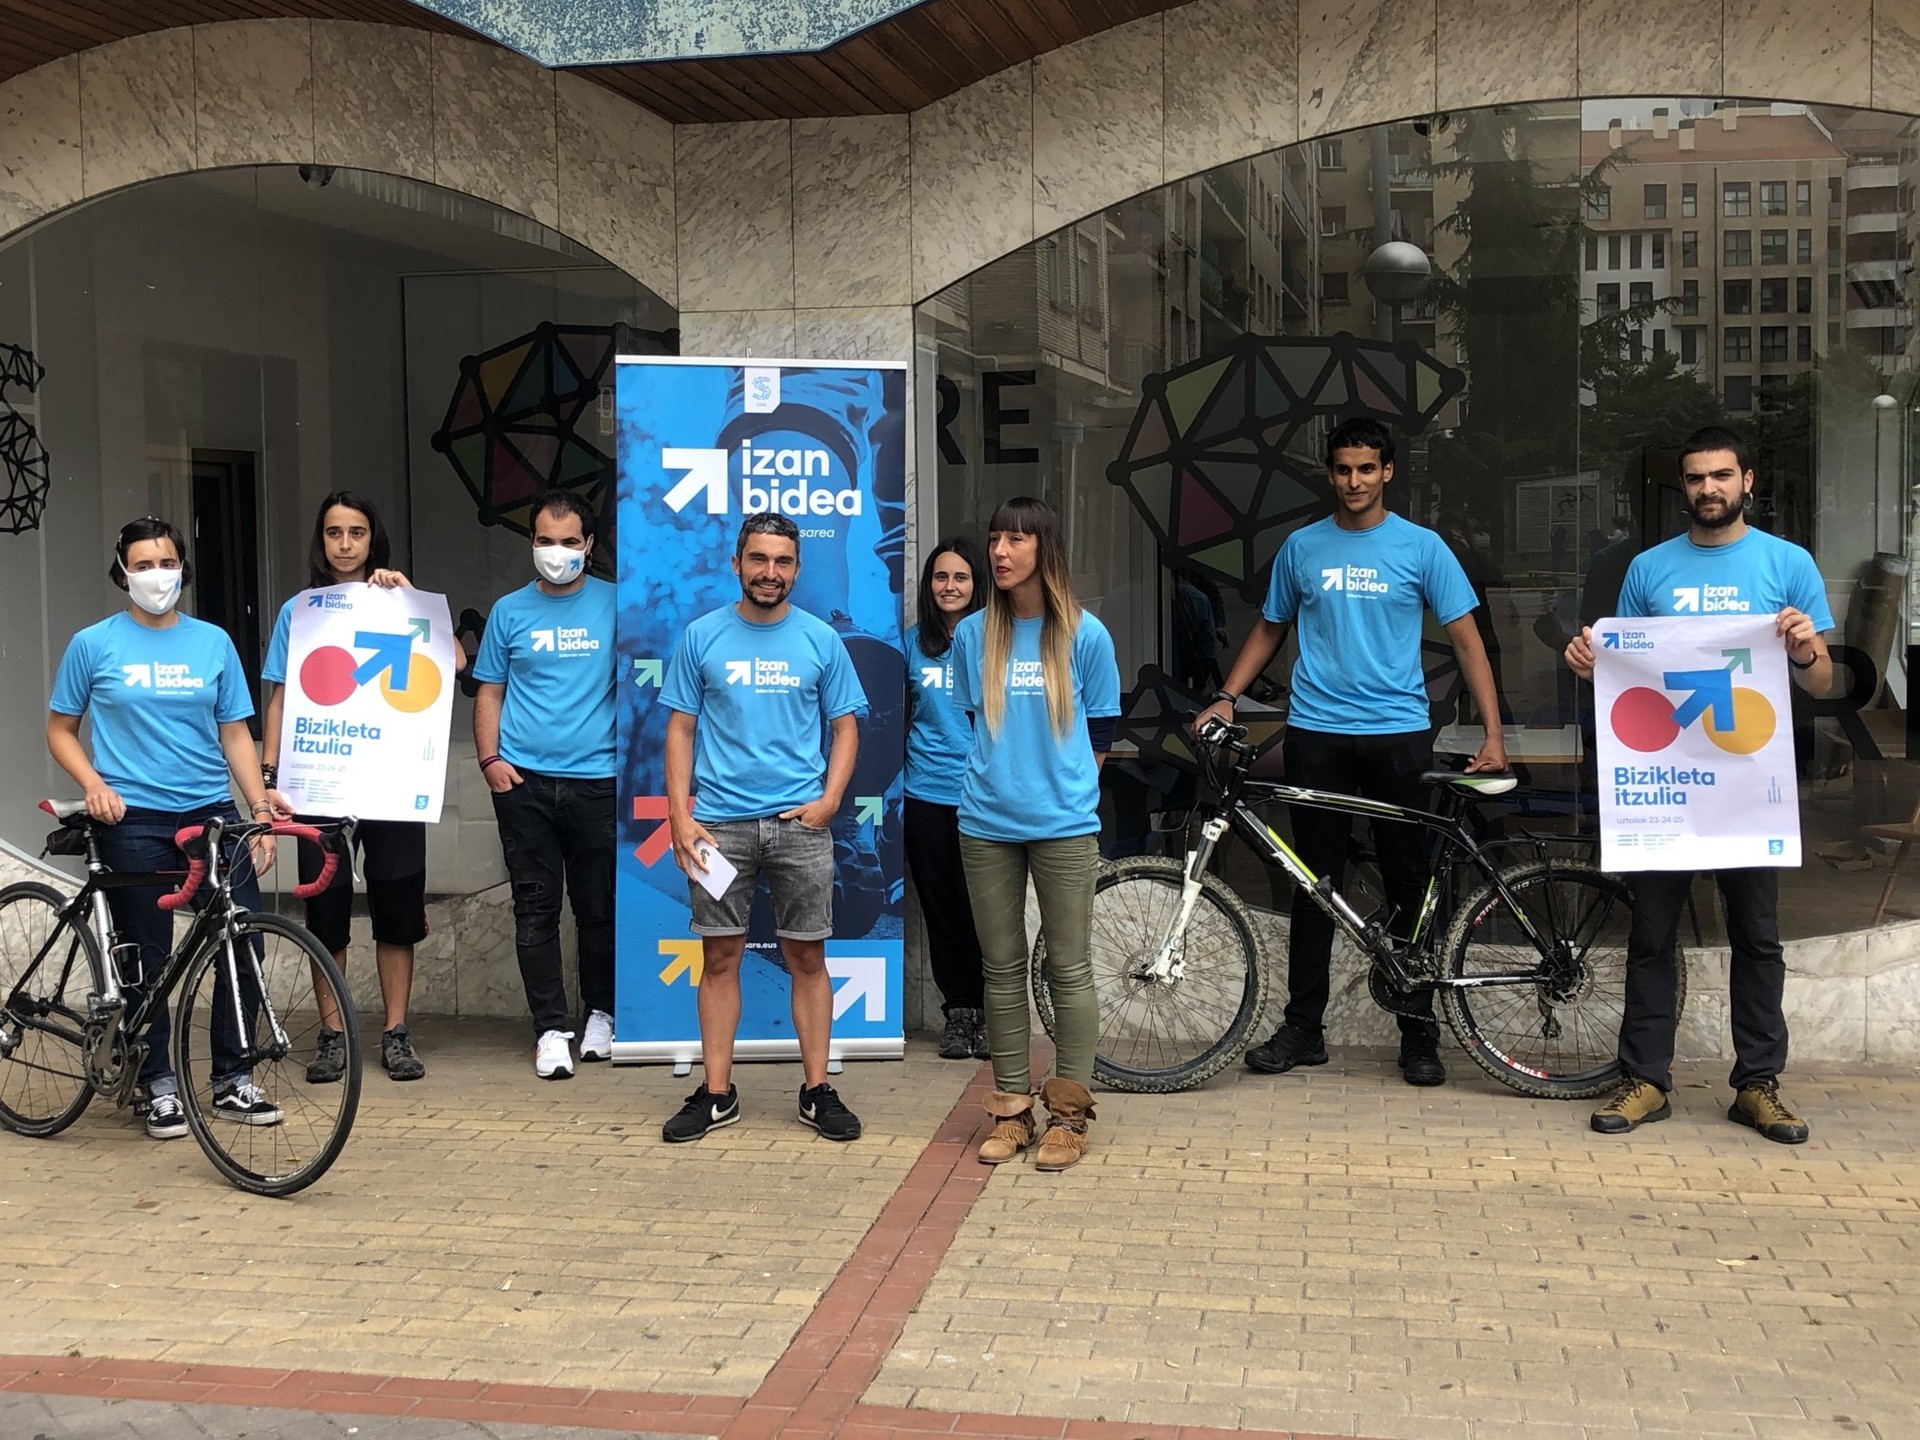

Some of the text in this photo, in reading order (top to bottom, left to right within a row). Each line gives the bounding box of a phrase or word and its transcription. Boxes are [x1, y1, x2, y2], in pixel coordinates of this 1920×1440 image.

[742, 439, 830, 476] izan
[742, 479, 862, 516] bidea
[799, 528, 835, 538] sarea
[1347, 564, 1378, 579] izan
[1346, 578, 1388, 593] bidea
[1703, 583, 1738, 597] izan
[326, 592, 347, 601] izan
[325, 600, 353, 610] bidea
[1703, 597, 1750, 612] bidea
[557, 626, 588, 638] izan
[1622, 629, 1646, 639] izan
[558, 638, 600, 651] bidea
[1622, 639, 1655, 649] bidea
[153, 661, 191, 675] izan
[755, 657, 789, 672] izan
[154, 674, 205, 689] bidea
[755, 671, 801, 688] bidea
[1011, 672, 1045, 687] bide
[295, 716, 382, 741] Bizikleta
[292, 735, 353, 756] itzulia
[1614, 766, 1716, 786] Bizikleta
[1614, 786, 1688, 806] itzulia
